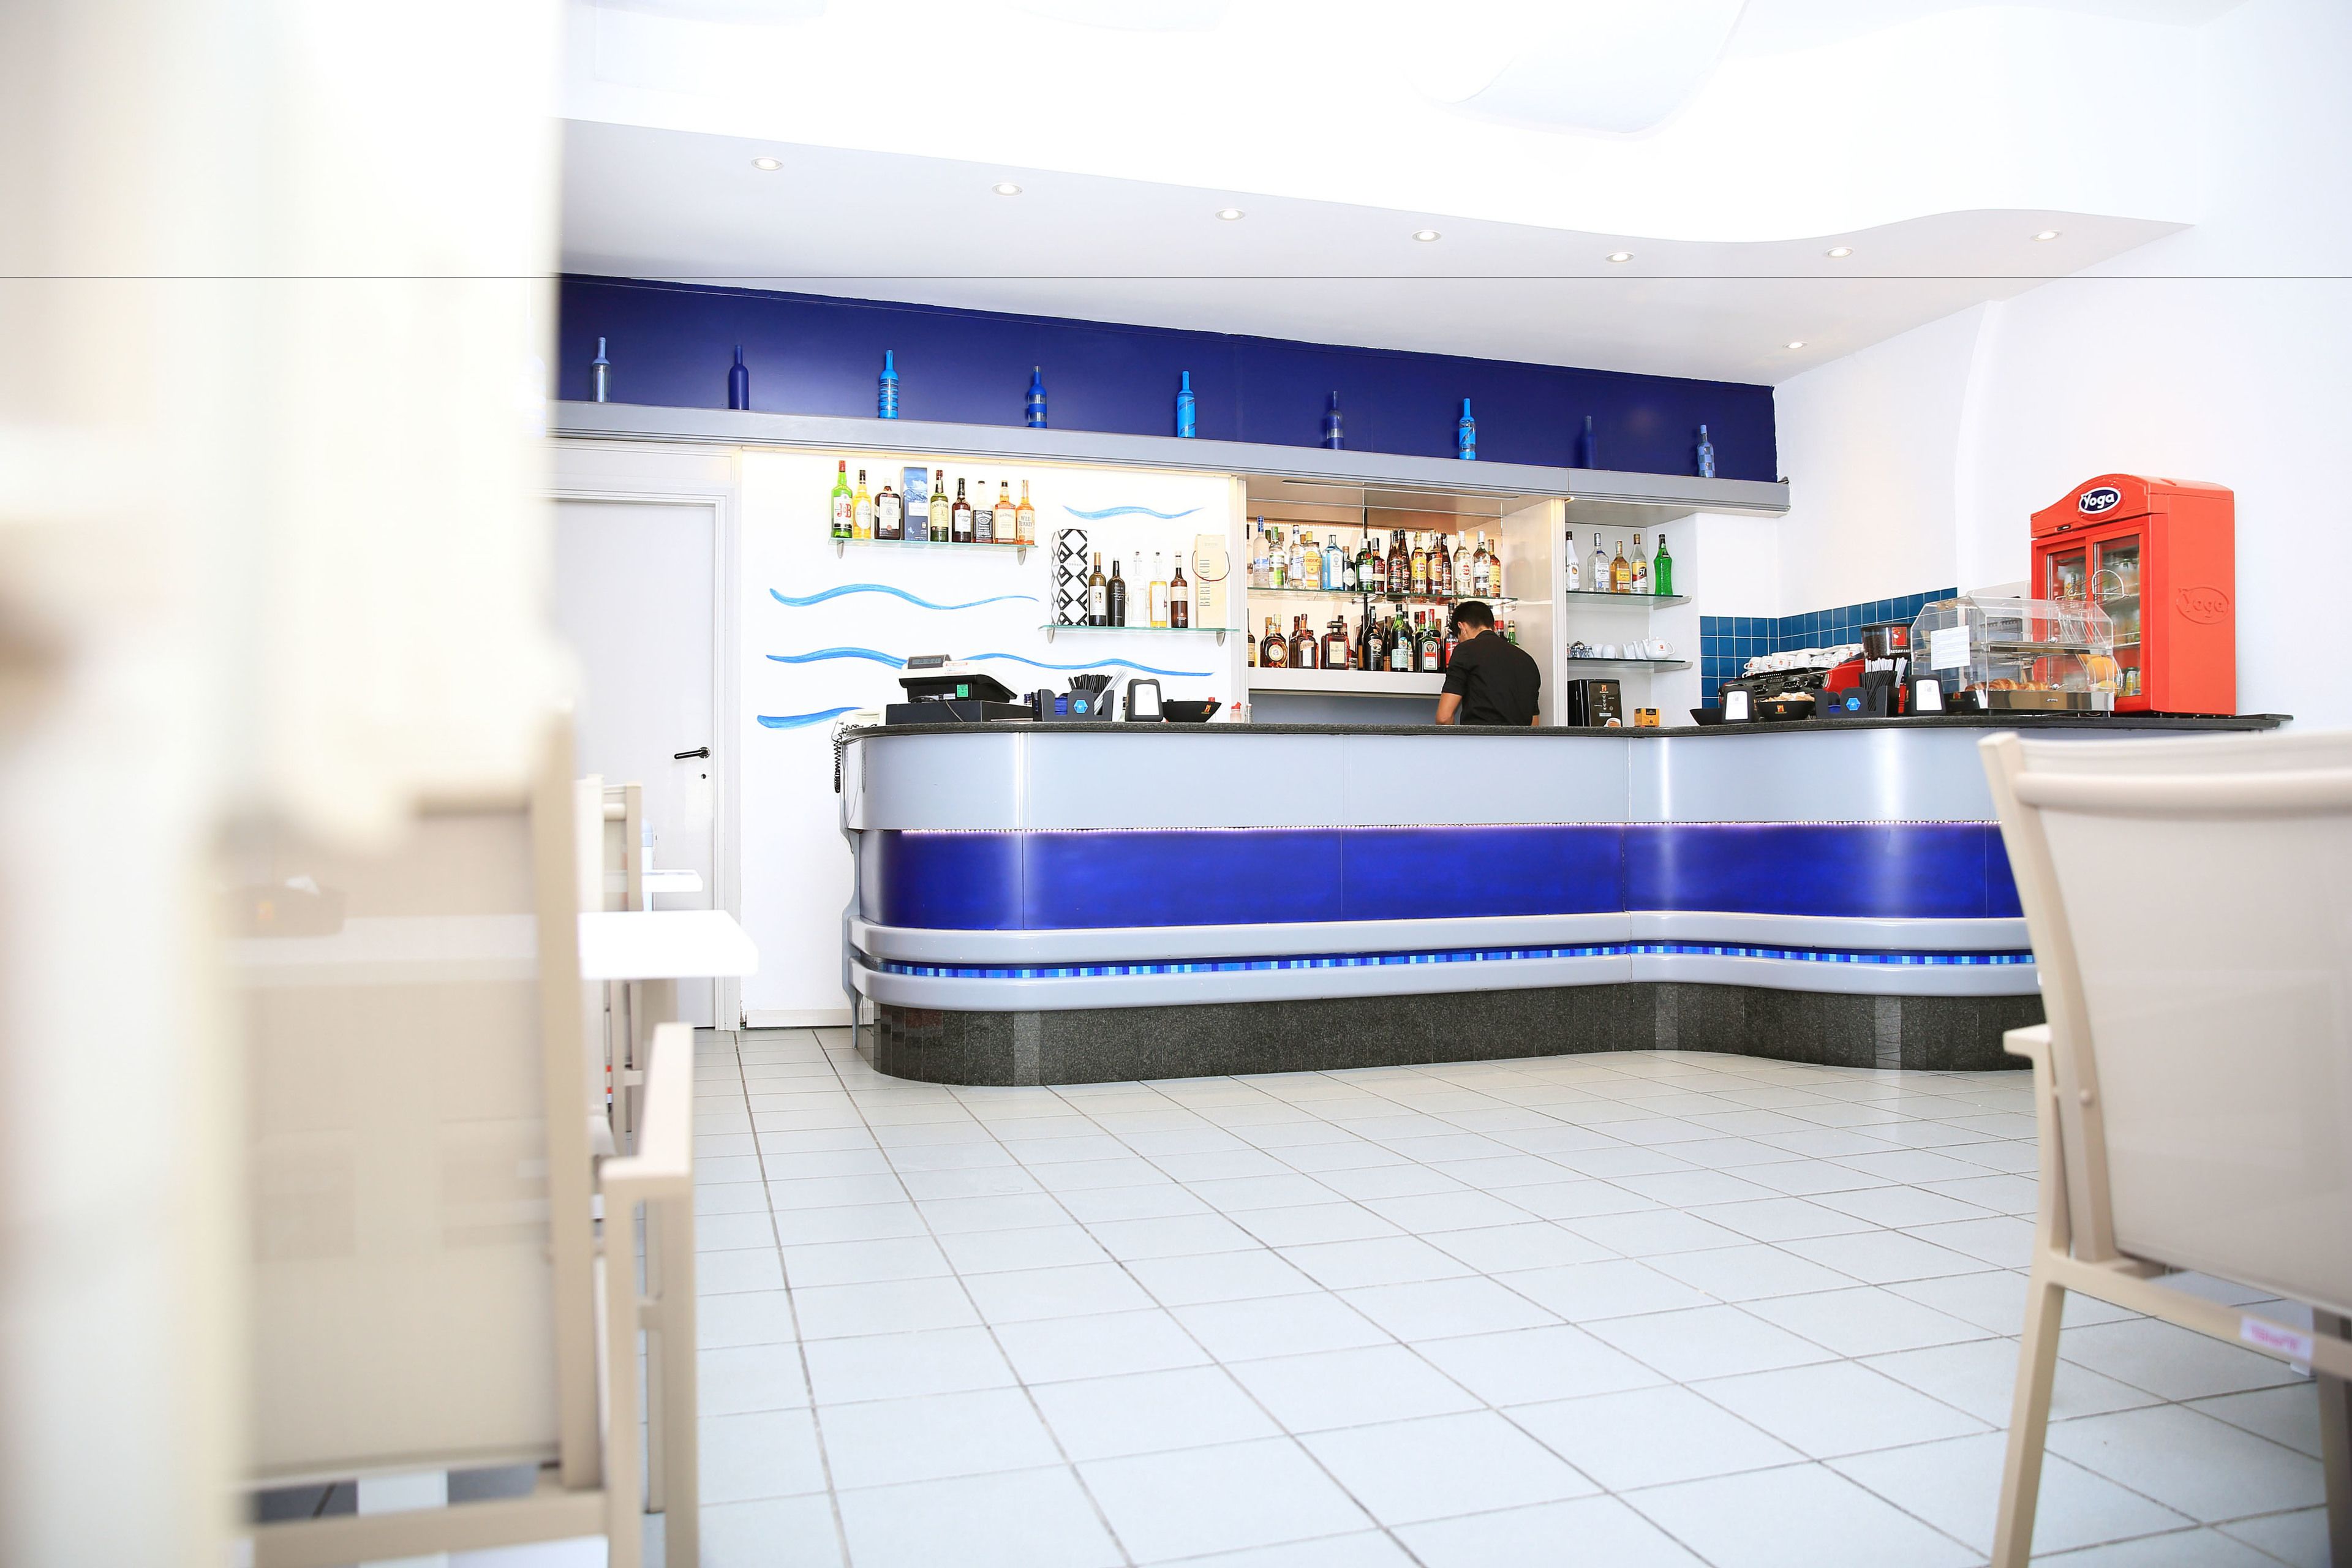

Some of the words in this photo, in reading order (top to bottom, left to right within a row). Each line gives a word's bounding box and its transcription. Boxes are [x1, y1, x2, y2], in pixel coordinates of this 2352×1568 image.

[837, 502, 851, 518] J&B
[2082, 493, 2115, 510] Yoga
[2182, 593, 2225, 619] Yoga
